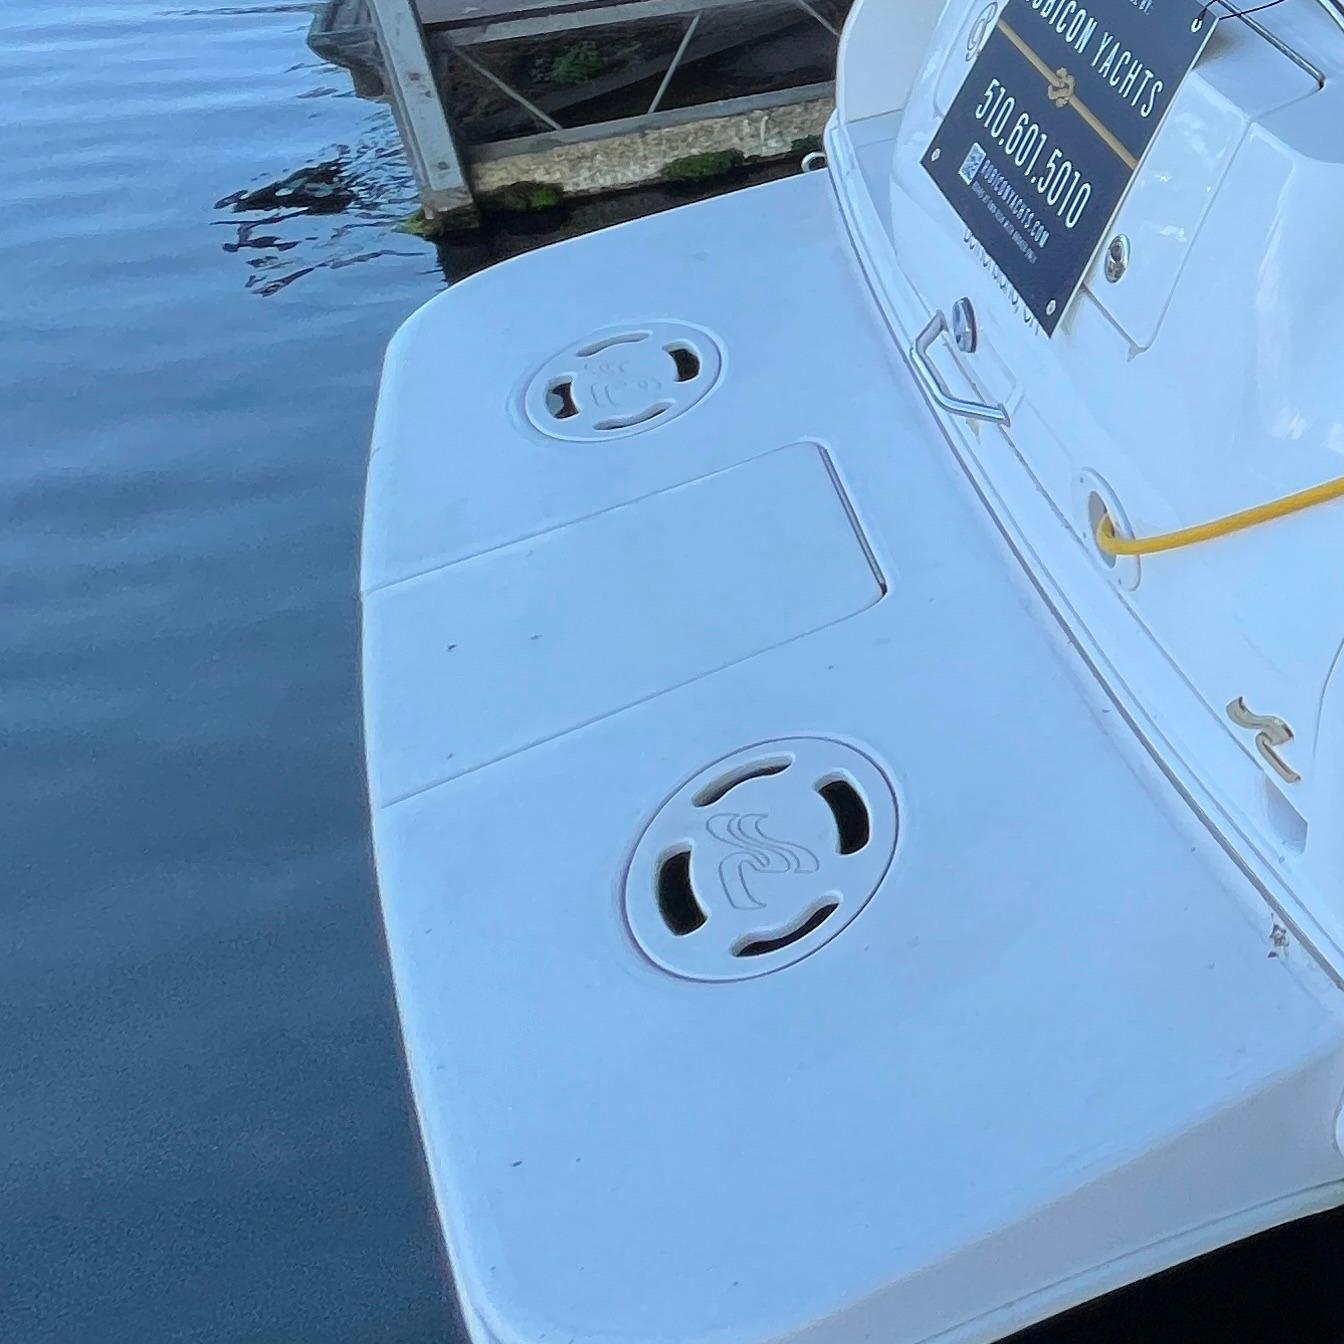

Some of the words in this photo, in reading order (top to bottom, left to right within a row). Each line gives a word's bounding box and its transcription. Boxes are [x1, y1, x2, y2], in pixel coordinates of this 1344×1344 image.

[1091, 31, 1163, 118] YACHTS
[975, 78, 1091, 228] 510.601.5010
[981, 159, 1050, 249] RUBICONYACHTS.COM
